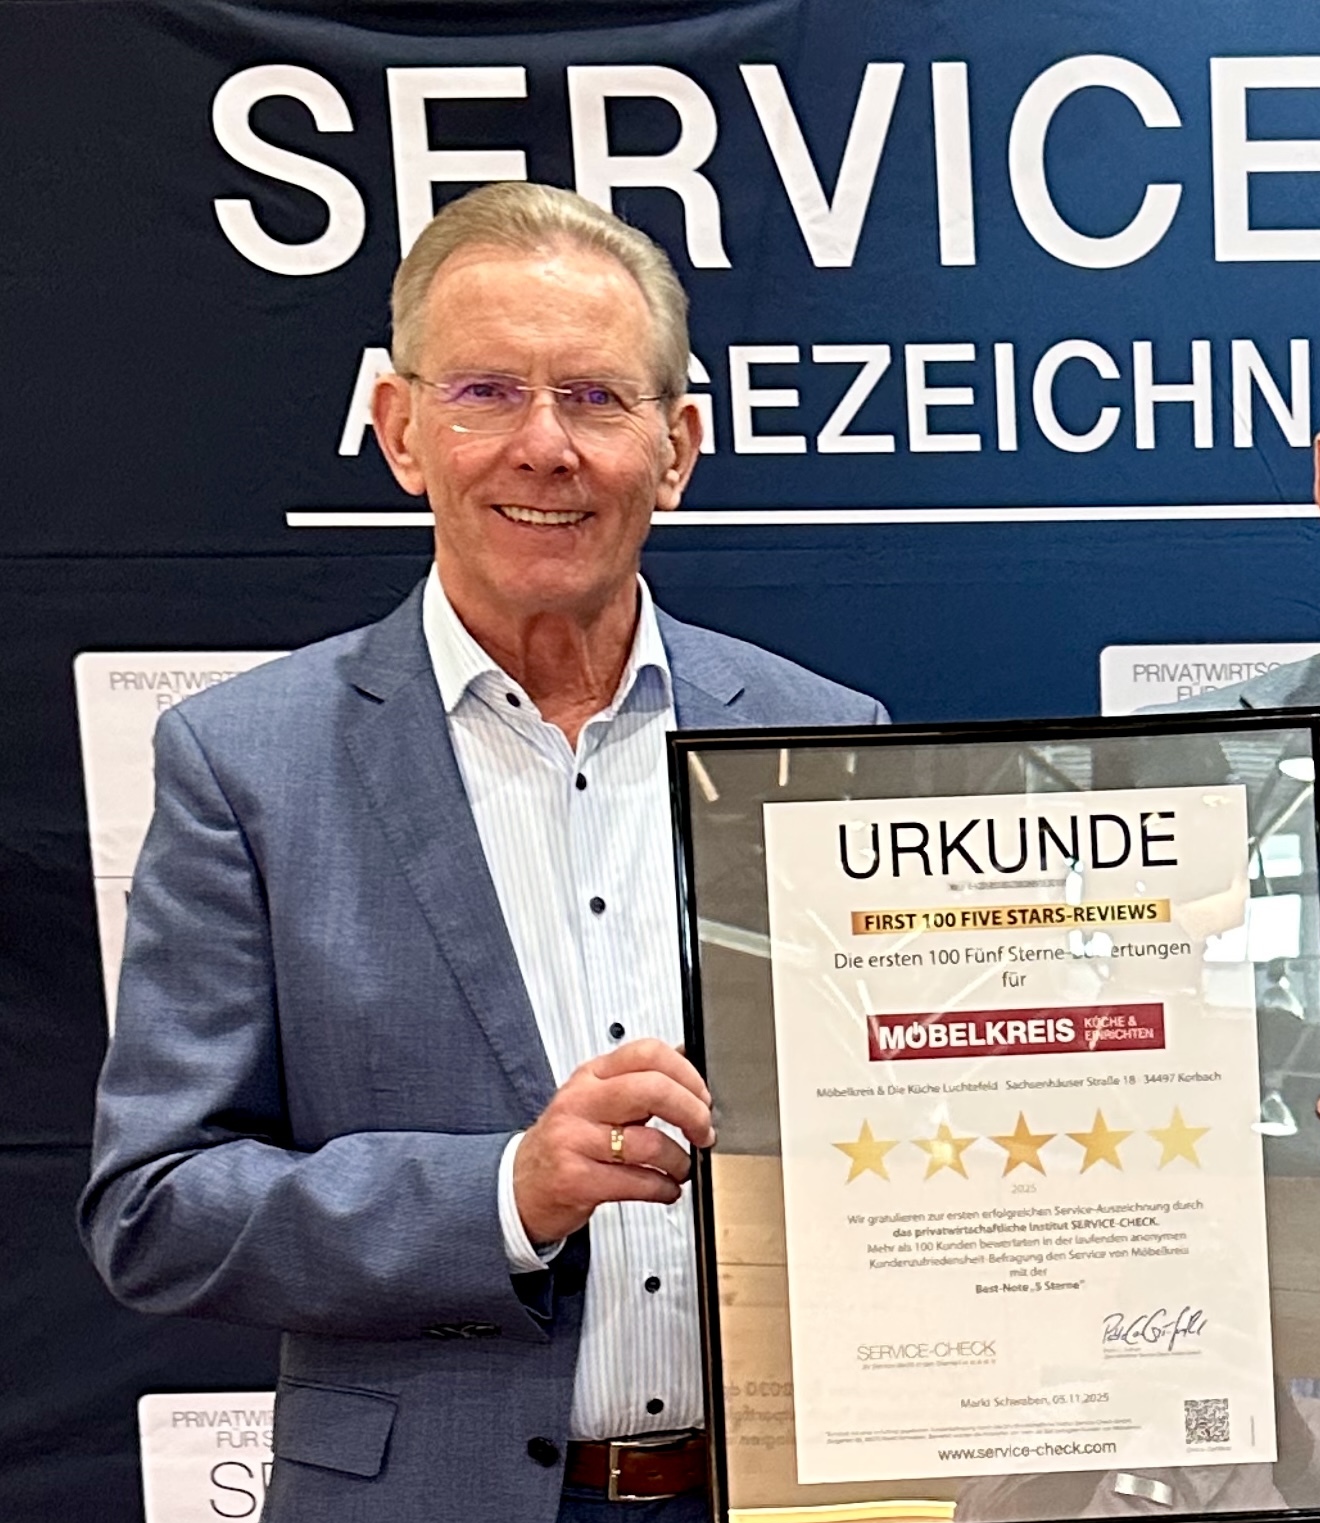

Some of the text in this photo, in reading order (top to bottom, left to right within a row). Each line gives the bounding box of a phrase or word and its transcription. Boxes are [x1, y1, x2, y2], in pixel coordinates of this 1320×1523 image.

[838, 811, 1178, 879] URKUNDE
[864, 903, 1157, 931] FIRST 100 FIVE STARS-REVIEWS
[834, 953, 864, 969] Die
[868, 952, 923, 968] ersten
[929, 949, 961, 965] 100
[965, 945, 1005, 964] Fünf
[1002, 970, 1027, 988] für
[1127, 1015, 1138, 1027] &
[816, 1086, 875, 1098] Möbelkreis
[876, 1085, 886, 1096] &
[887, 1084, 906, 1096] Die
[907, 1083, 940, 1095] Küche
[1086, 1075, 1120, 1088] Straße
[1123, 1075, 1136, 1087] 18
[1144, 1072, 1176, 1085] 34497
[1177, 1071, 1222, 1084] Korbach
[847, 1214, 866, 1225] Wir
[867, 1212, 926, 1227] gratulieren
[927, 1212, 944, 1222] zur
[946, 1210, 980, 1221] ersten
[1172, 1199, 1204, 1211] durch
[892, 1227, 913, 1238] das
[914, 1222, 1027, 1239] privatwirtschaftliche
[1029, 1220, 1069, 1232] Institut
[866, 1243, 895, 1254] Mehr
[897, 1242, 913, 1252] als
[915, 1241, 935, 1252] 100
[936, 1239, 977, 1251] Kunden
[1042, 1235, 1053, 1246] in
[1054, 1234, 1073, 1247] der
[1045, 1251, 1067, 1262] den
[1068, 1248, 1106, 1261] Service
[1108, 1248, 1129, 1259] von
[1009, 1266, 1048, 1278] mit der
[856, 1339, 997, 1362] SERVICE-CHECK
[937, 1441, 1117, 1461] www.service-check.com
